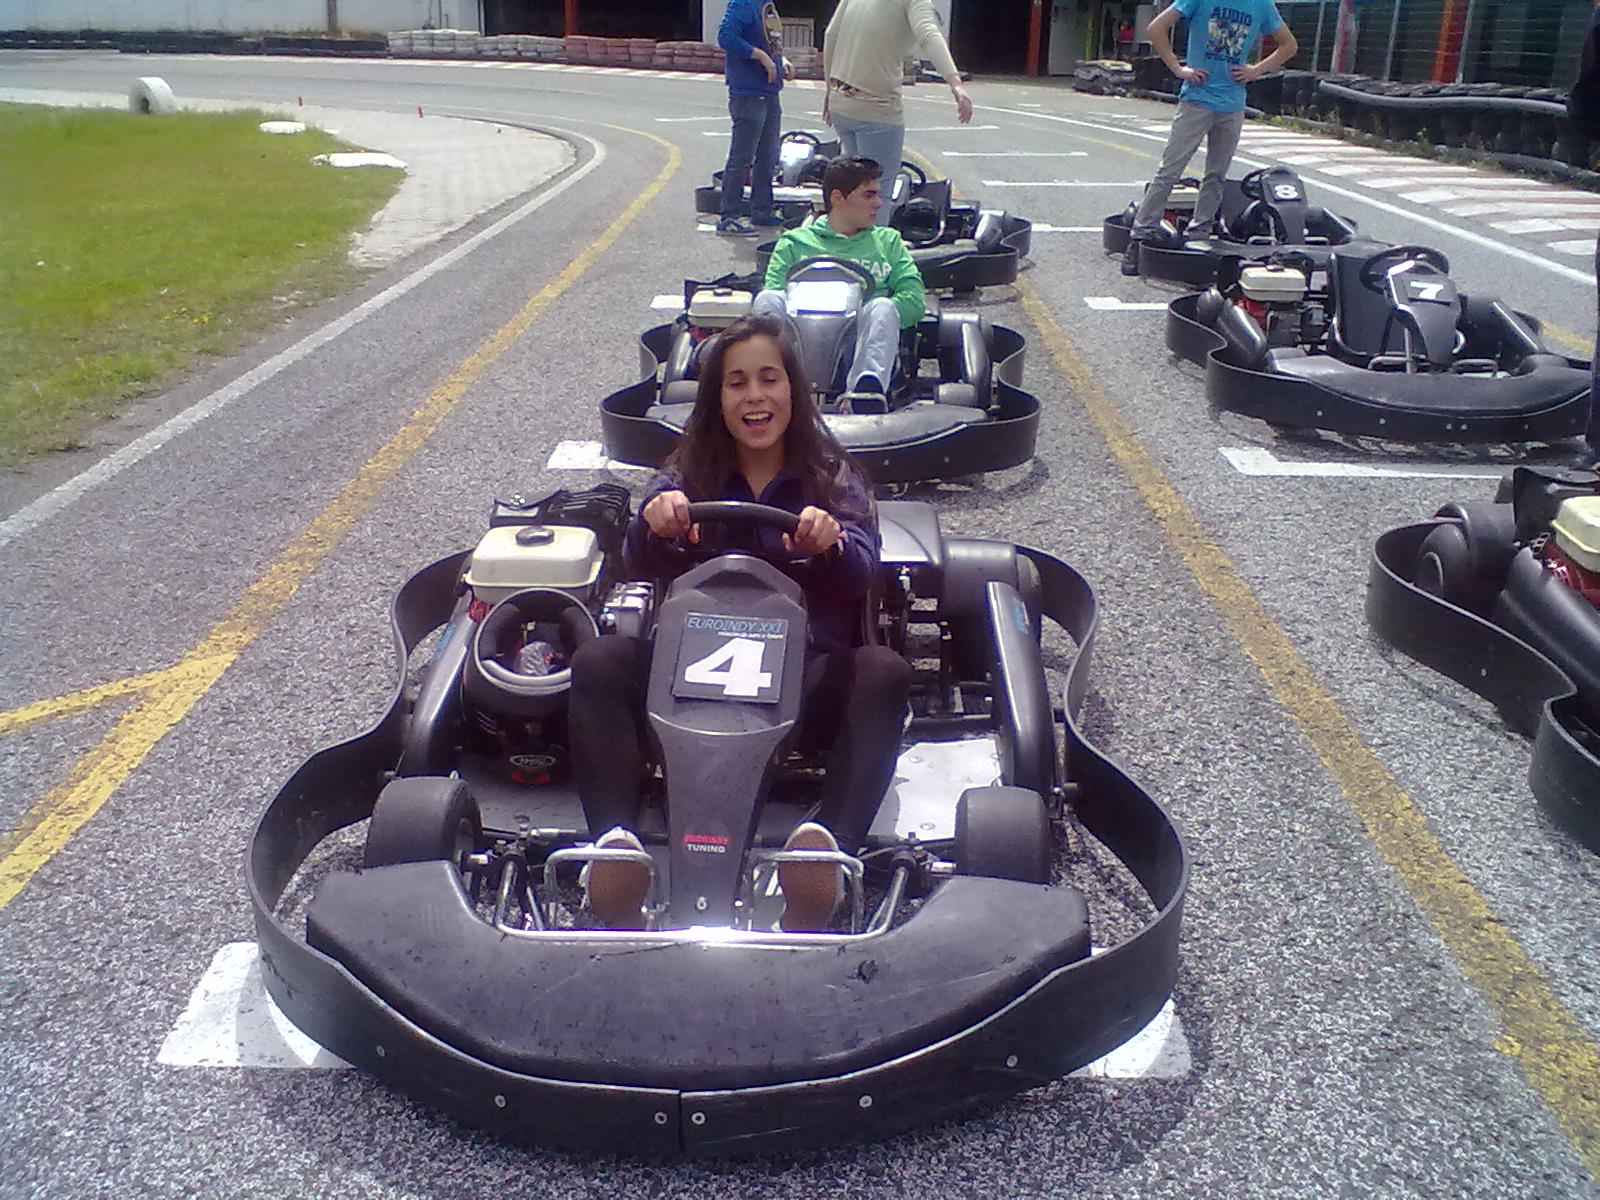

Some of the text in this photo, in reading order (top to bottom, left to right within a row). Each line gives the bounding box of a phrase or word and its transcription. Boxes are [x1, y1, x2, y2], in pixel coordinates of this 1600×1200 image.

[1211, 6, 1253, 27] AUDIO
[1274, 184, 1299, 199] 8
[1410, 281, 1444, 300] 7
[687, 616, 784, 634] EUROINDY XXI
[684, 637, 773, 697] 4
[687, 843, 727, 854] TUNING
